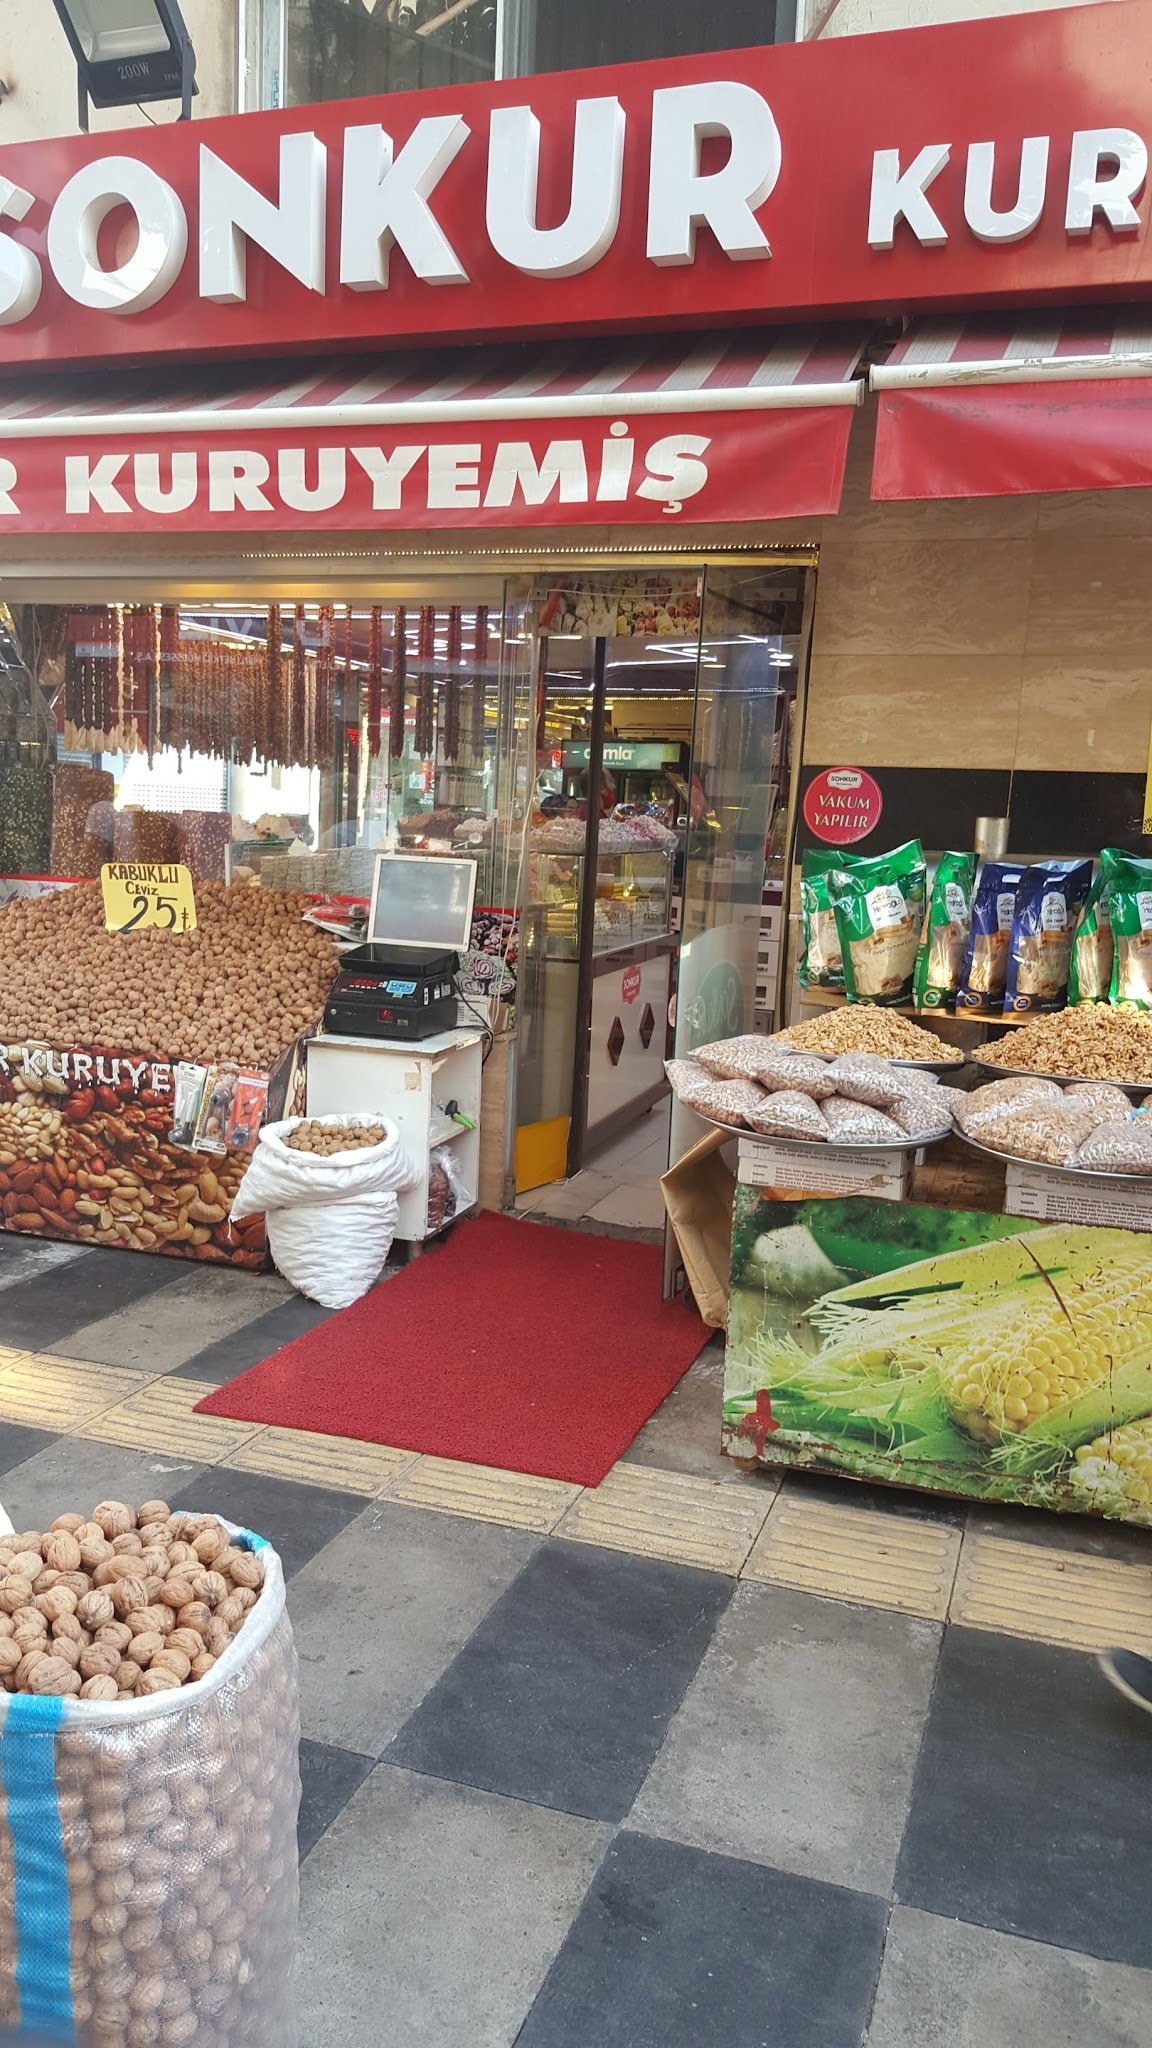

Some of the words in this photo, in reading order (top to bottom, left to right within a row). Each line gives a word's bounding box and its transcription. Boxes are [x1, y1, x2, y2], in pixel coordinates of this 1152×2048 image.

[117, 62, 150, 79] 200W
[866, 128, 1149, 251] KUR
[64, 421, 712, 514] KURUYEMİŞ
[830, 775, 858, 783] SONKUR
[819, 792, 870, 810] VAKUM
[814, 812, 868, 828] YAPILIR
[108, 864, 179, 884] KABUKLU
[21, 1047, 171, 1097] KURUYE
